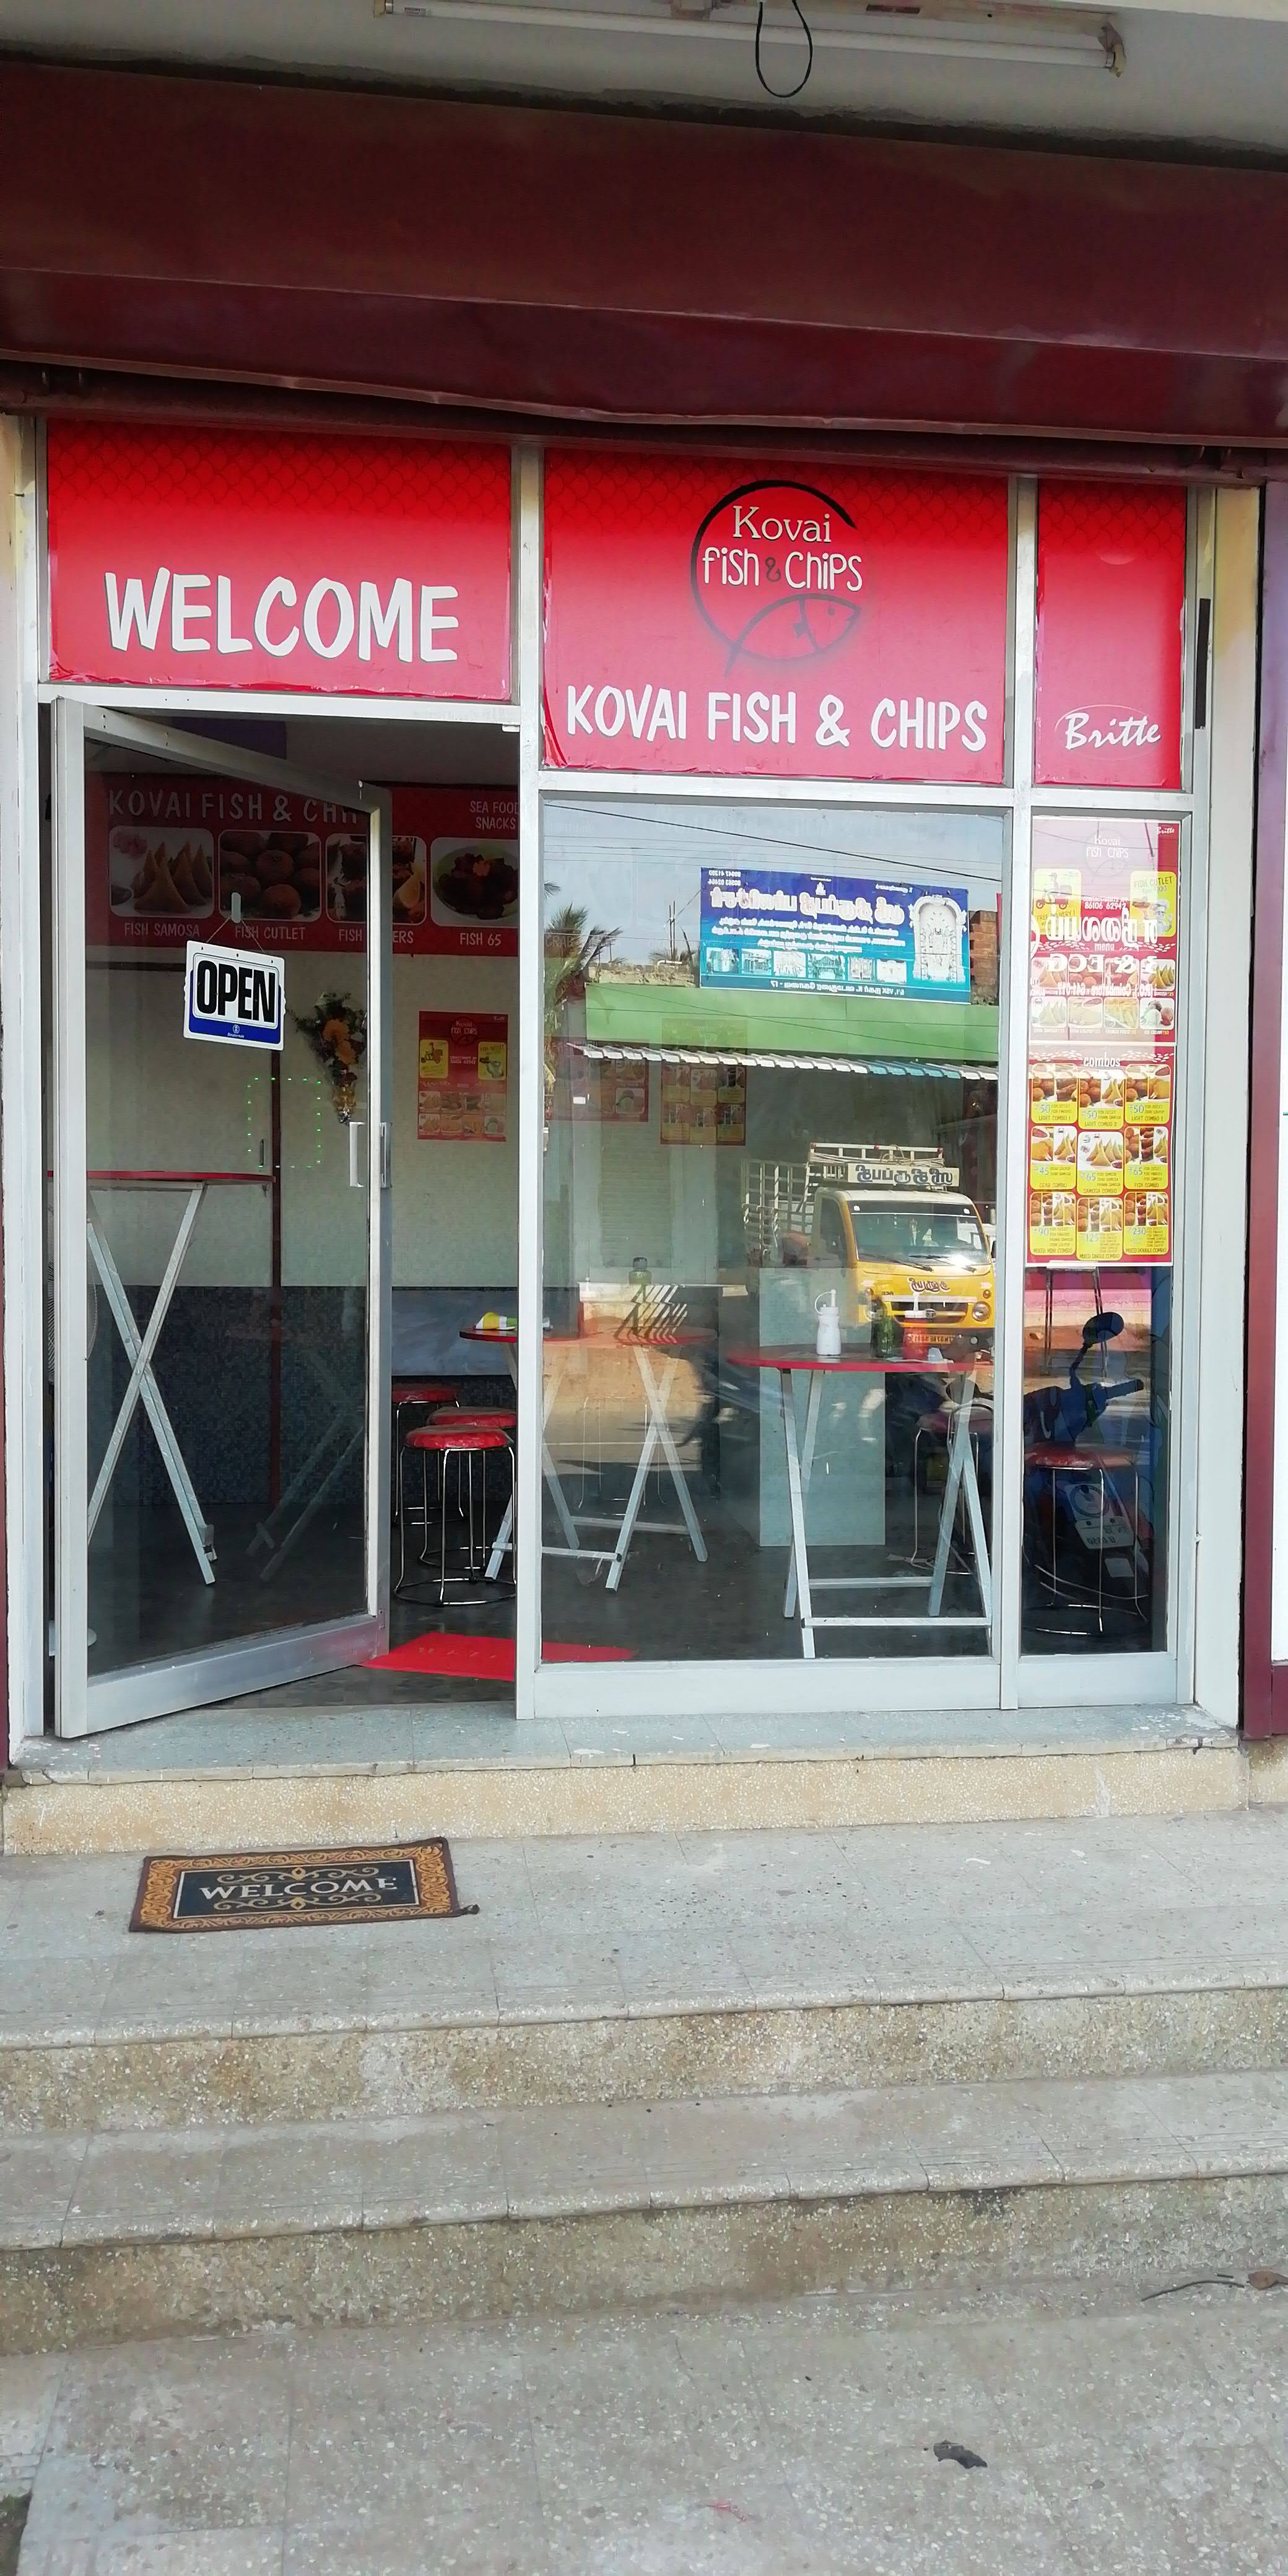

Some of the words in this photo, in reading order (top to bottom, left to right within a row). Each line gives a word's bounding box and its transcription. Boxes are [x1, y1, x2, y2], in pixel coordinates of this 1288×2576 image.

[733, 505, 832, 544] Kovai
[105, 567, 458, 663] WELCOME
[567, 683, 687, 742] KOVAI
[708, 691, 796, 744] FISH
[815, 694, 851, 748] &
[871, 697, 988, 752] CHIPS
[1064, 712, 1162, 751] Britte
[108, 789, 190, 819] KOVAI
[201, 793, 263, 820] FISH
[272, 794, 292, 822] &
[303, 798, 357, 825] CHI
[469, 800, 489, 814] SEA
[475, 816, 516, 830] SNACKS
[1094, 835, 1120, 846] Kovai
[123, 923, 149, 937] FISH
[152, 923, 201, 938] SAMOSA
[234, 926, 259, 939] FISH
[263, 926, 307, 941] CUTLET
[338, 929, 363, 942] FISH
[459, 932, 483, 946] FISH
[487, 933, 502, 947] 65
[1094, 943, 1115, 952] menu
[196, 960, 276, 1024] OPEN
[1084, 1052, 1121, 1068] combos
[199, 1877, 399, 1900] WELCOME
